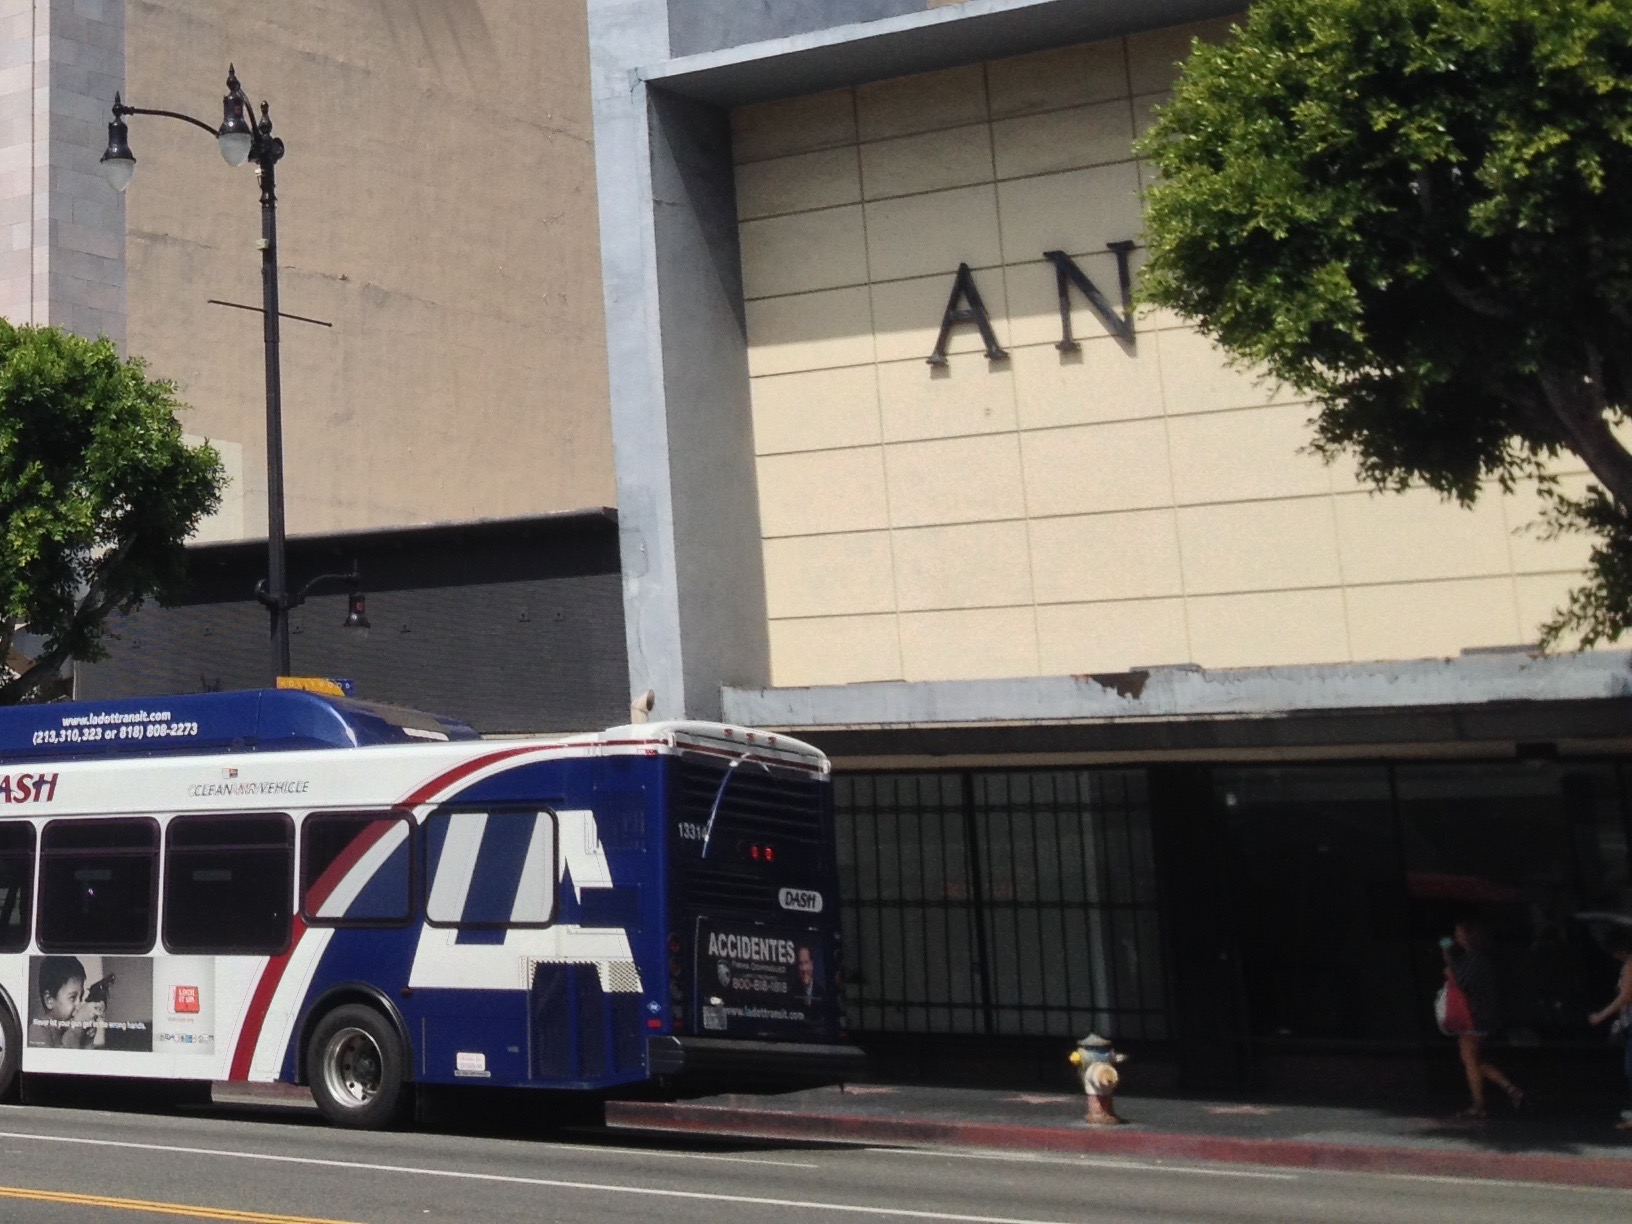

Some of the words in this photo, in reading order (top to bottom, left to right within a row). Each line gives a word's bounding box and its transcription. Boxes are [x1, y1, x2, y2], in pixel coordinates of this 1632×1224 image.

[62, 710, 171, 727] www.ladottransit.com
[32, 728, 103, 746] (213,310,323
[104, 728, 118, 740] or
[119, 725, 144, 740] 818)
[146, 722, 198, 737] 808-2273
[192, 783, 233, 796] CLEAN
[259, 781, 310, 795] VEHICLE
[408, 809, 645, 994] LA
[784, 889, 817, 909] DASH
[708, 931, 797, 966] ACCIDENTES
[109, 1022, 127, 1031] wrong
